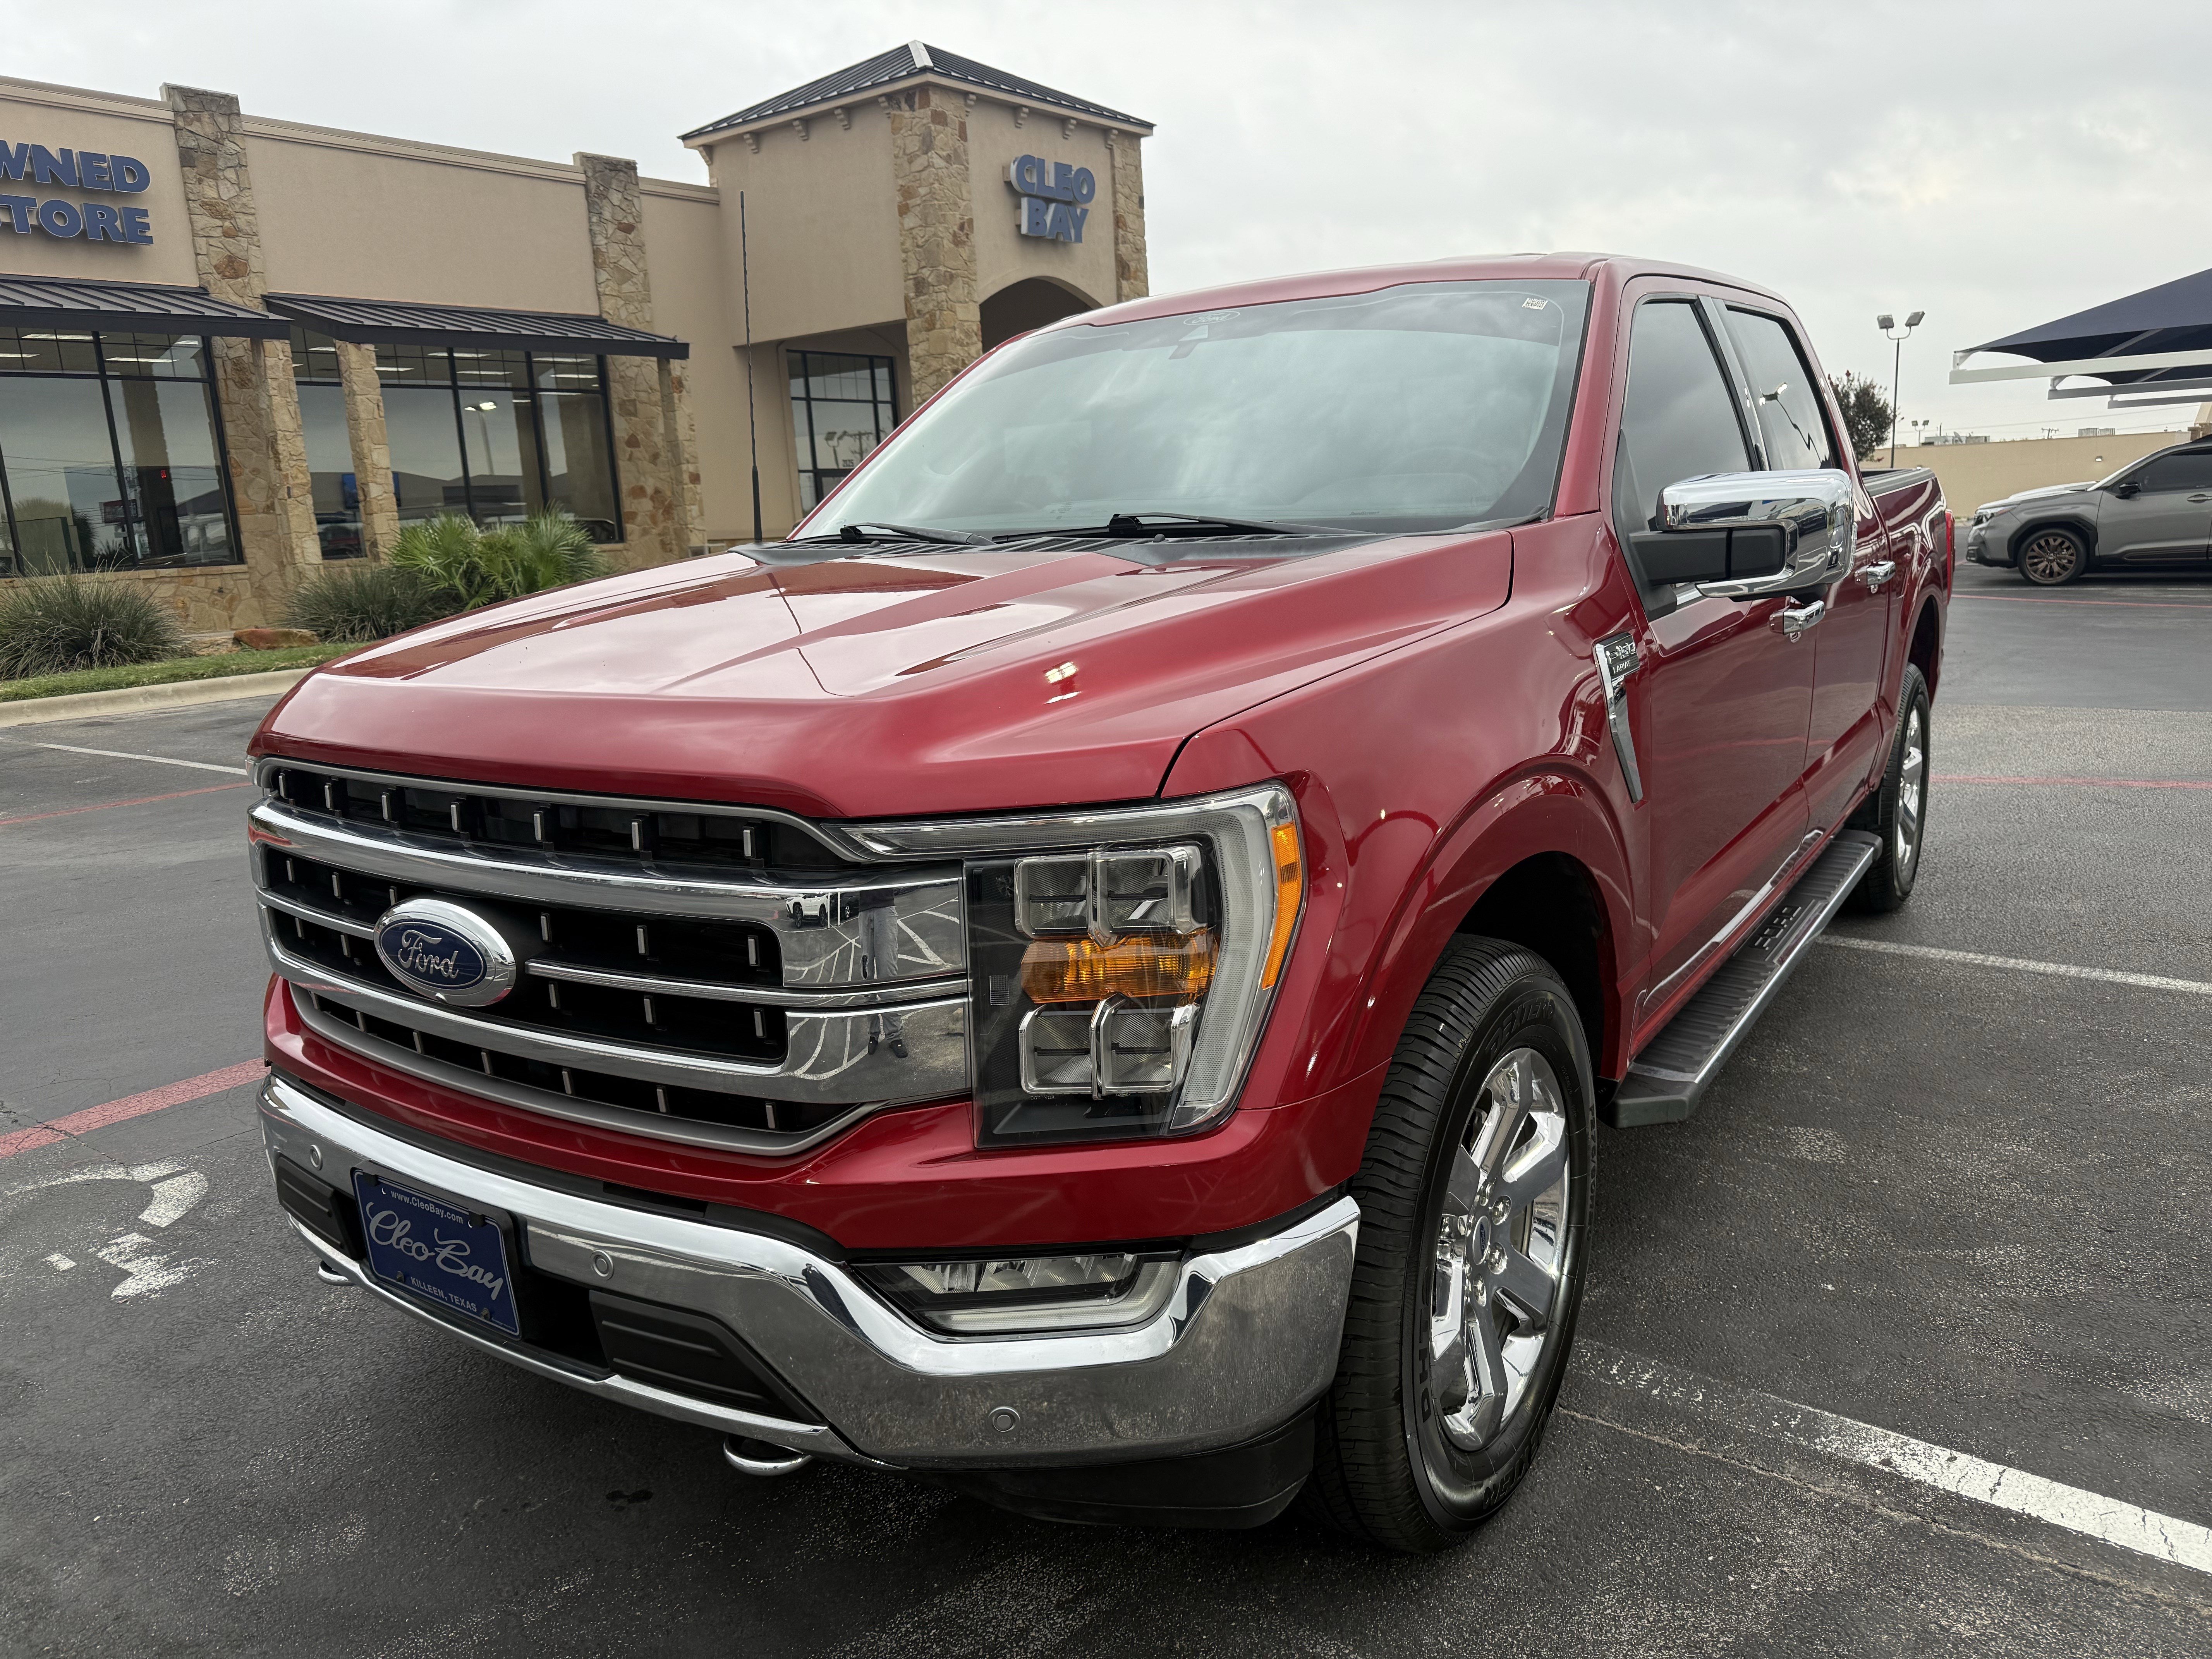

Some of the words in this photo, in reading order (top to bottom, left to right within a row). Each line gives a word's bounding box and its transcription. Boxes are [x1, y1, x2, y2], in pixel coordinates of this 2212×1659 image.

[1011, 154, 1096, 204] CLEO
[0, 194, 154, 245] TORE
[1022, 197, 1089, 244] BAY
[1606, 642, 1637, 665] F-150
[1612, 660, 1631, 674] LARIAT
[1752, 906, 1802, 951] FORD
[397, 929, 459, 979] Ford
[1485, 997, 1555, 1064] DEXTERO
[390, 1190, 464, 1225] www.CleoBay.com
[366, 1201, 436, 1262] Cleo
[434, 1228, 504, 1301] Bay
[410, 1276, 448, 1301] KILLEEN,
[448, 1293, 477, 1312] TEXAS
